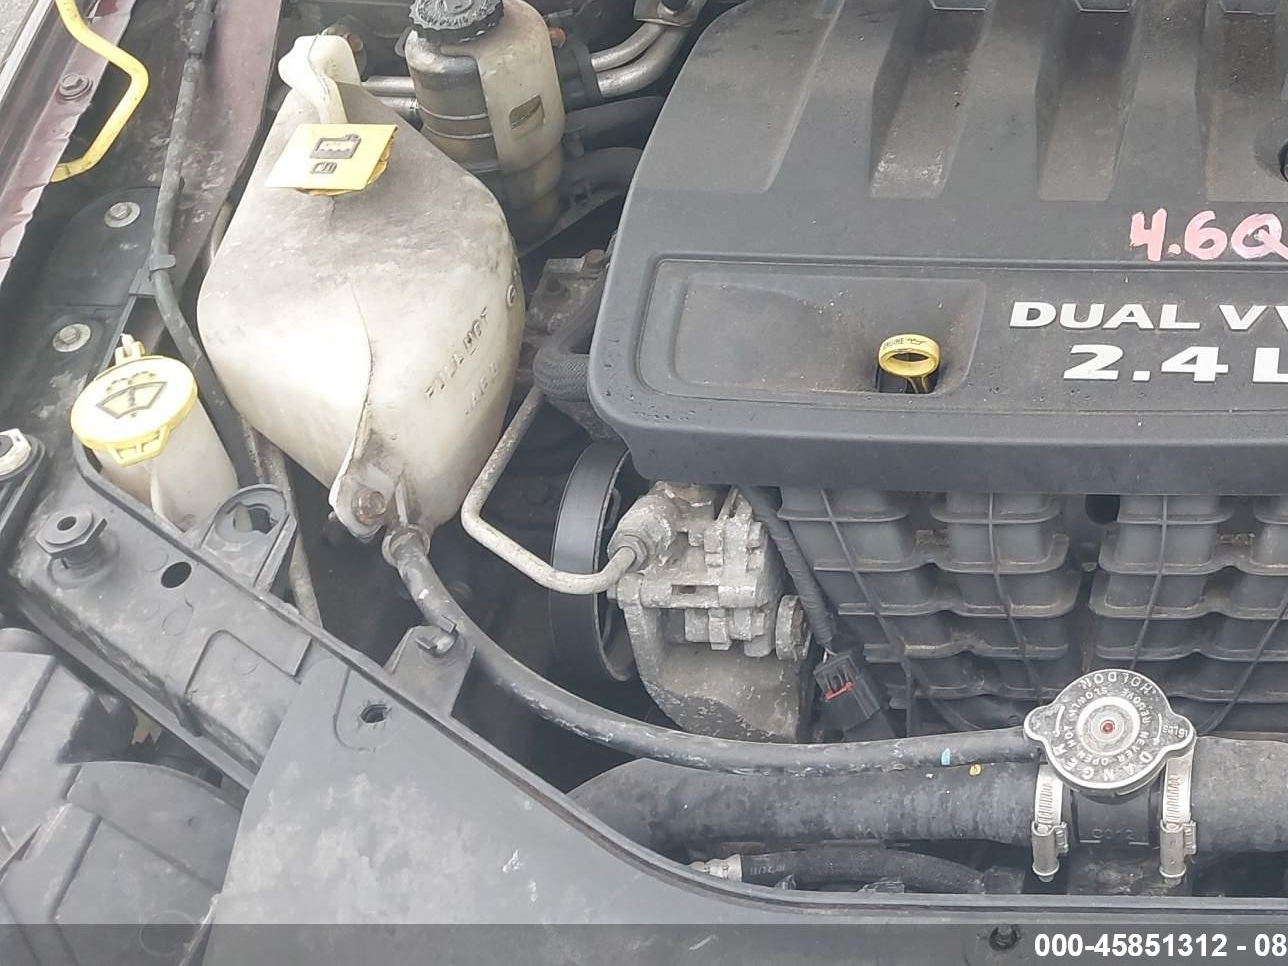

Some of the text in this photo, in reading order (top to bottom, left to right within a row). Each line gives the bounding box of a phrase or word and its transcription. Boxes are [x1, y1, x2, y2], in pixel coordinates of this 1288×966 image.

[1009, 301, 1201, 331] DUAL
[1052, 743, 1153, 782] DANGER
[1062, 724, 1150, 766] NEVER OPEN HOT
